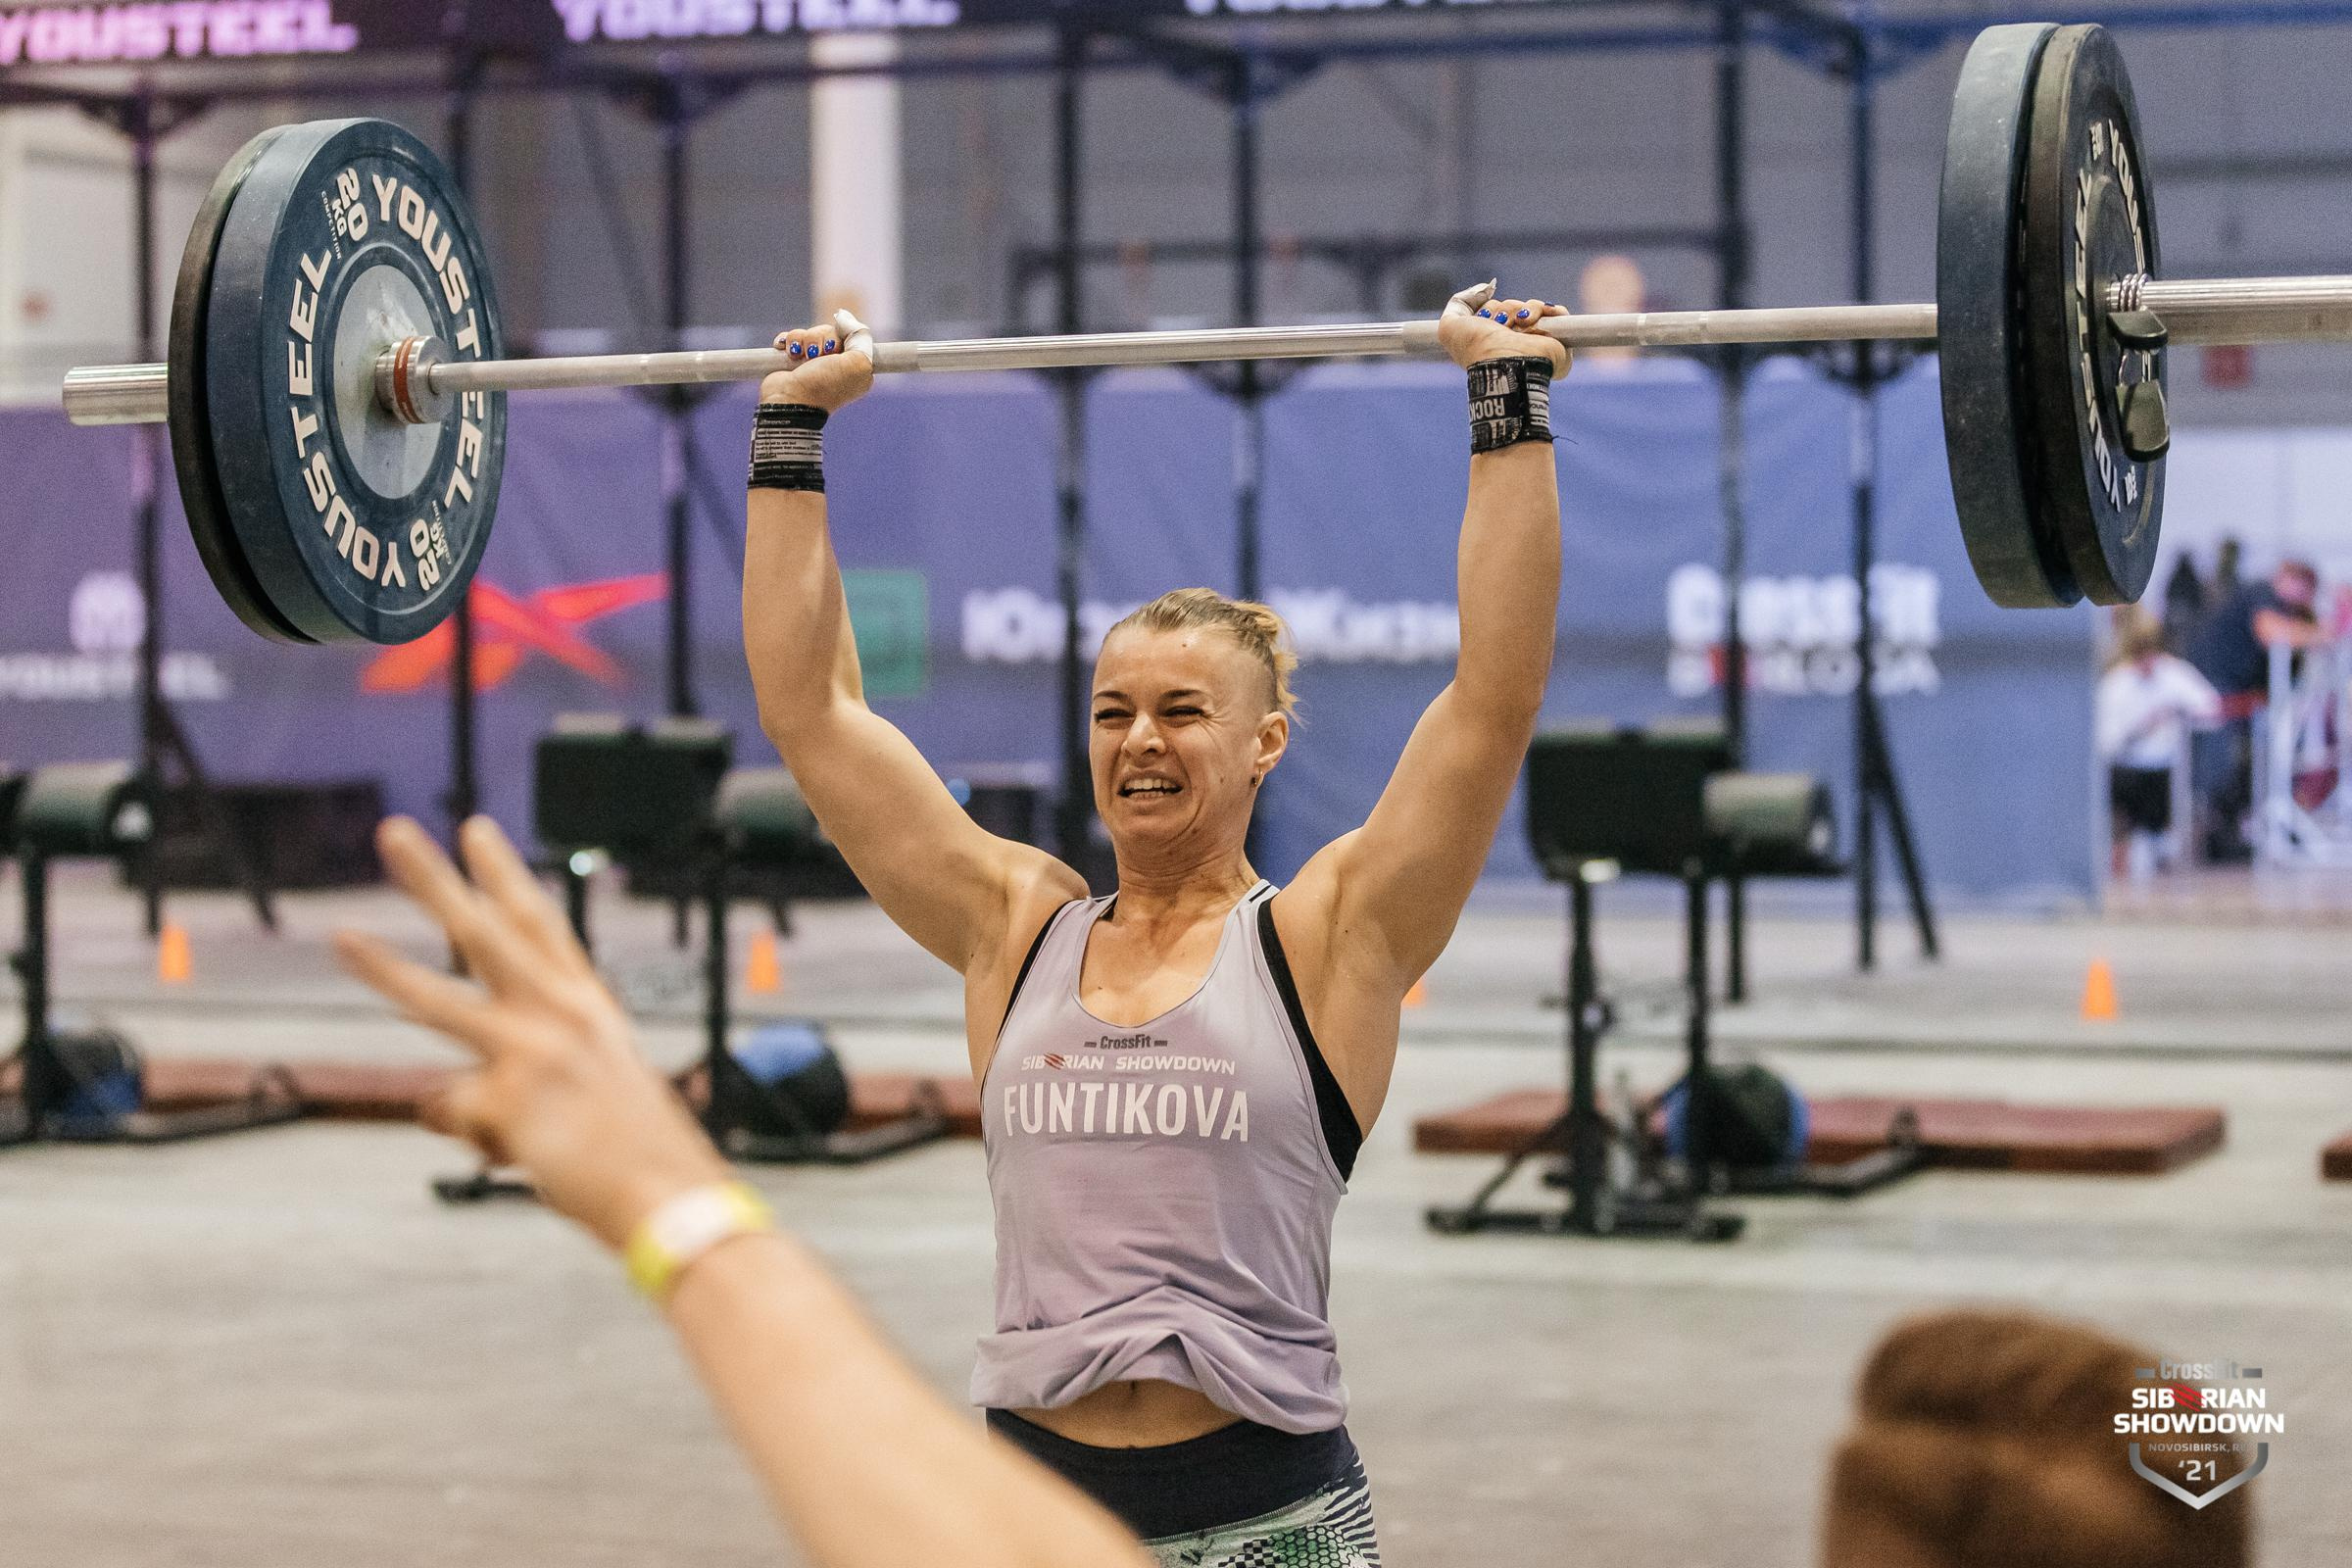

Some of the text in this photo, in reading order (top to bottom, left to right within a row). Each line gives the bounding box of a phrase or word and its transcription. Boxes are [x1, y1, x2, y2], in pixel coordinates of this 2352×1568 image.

[287, 249, 407, 588] YOUSTEEL
[1100, 1033, 1152, 1051] CrossFit
[1114, 1054, 1237, 1076] SHOWDOWN
[1003, 1081, 1250, 1144] FUNTIKOVA
